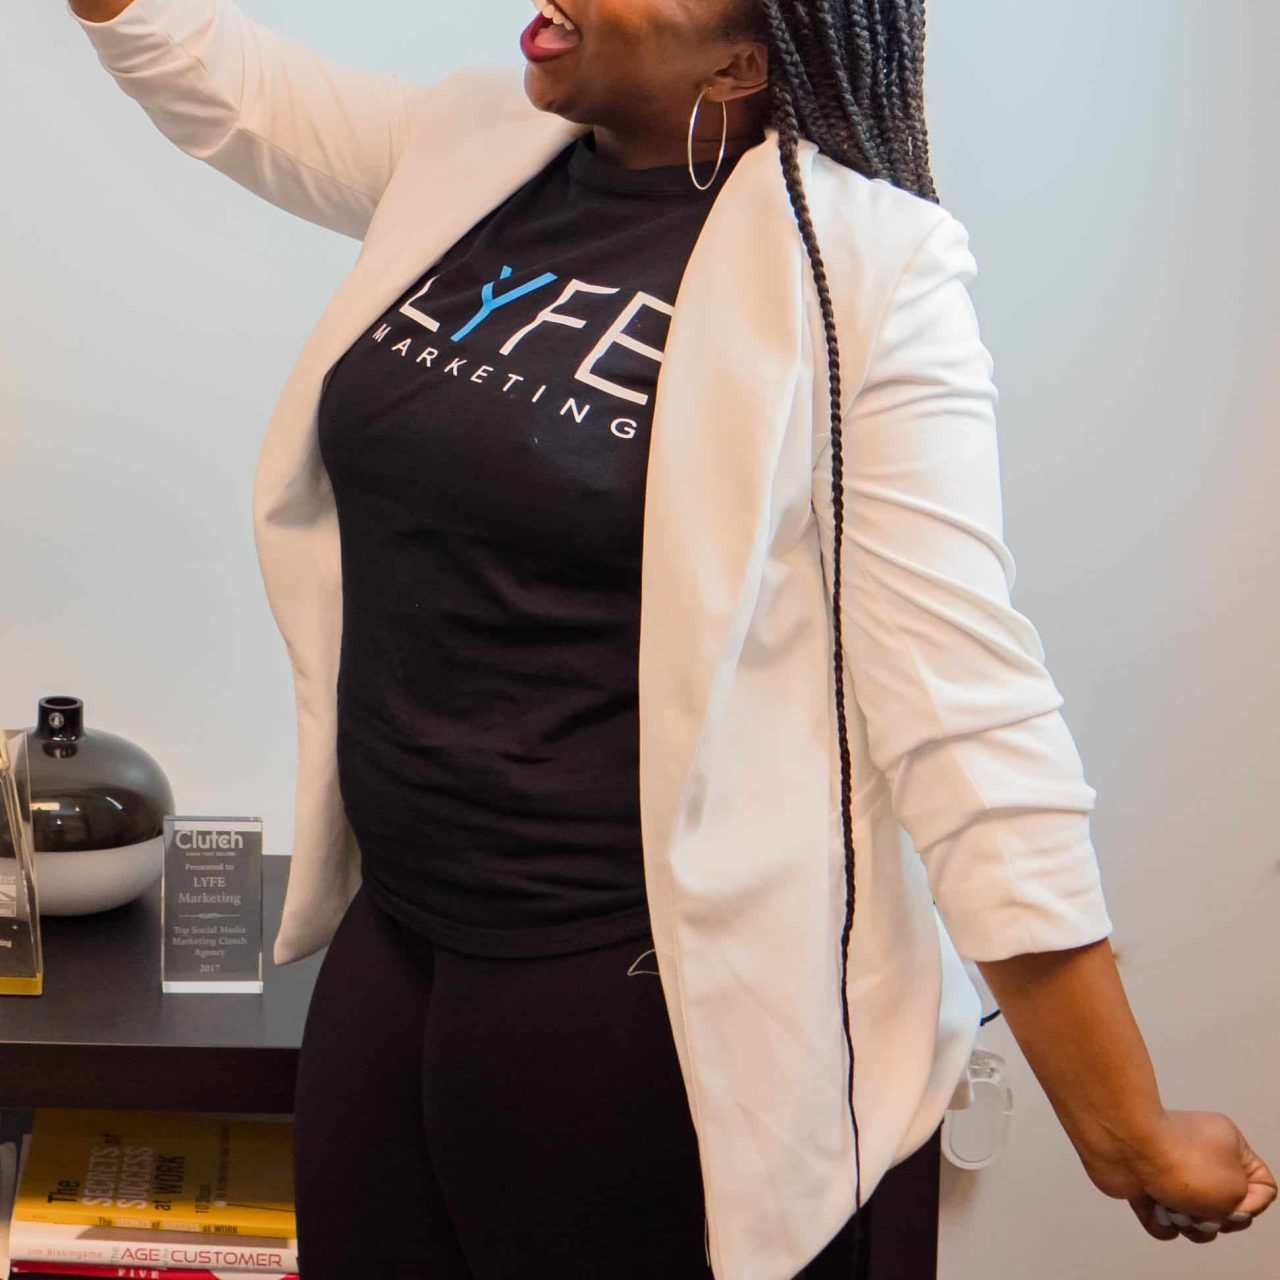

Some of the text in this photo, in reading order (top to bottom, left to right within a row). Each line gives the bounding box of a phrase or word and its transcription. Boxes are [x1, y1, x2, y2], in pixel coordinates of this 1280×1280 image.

[398, 265, 675, 406] LYFE
[372, 323, 637, 439] MARKETING
[175, 830, 244, 849] Clutch
[193, 876, 226, 888] LYFE
[178, 892, 242, 905] Marketing
[82, 1146, 119, 1207] SECRETS
[116, 1146, 153, 1210] SUCCESS
[153, 1155, 185, 1195] WORK
[48, 1180, 80, 1204] The
[152, 1199, 171, 1211] at
[120, 1247, 160, 1262] AGE
[171, 1249, 282, 1267] CUSTOMER
